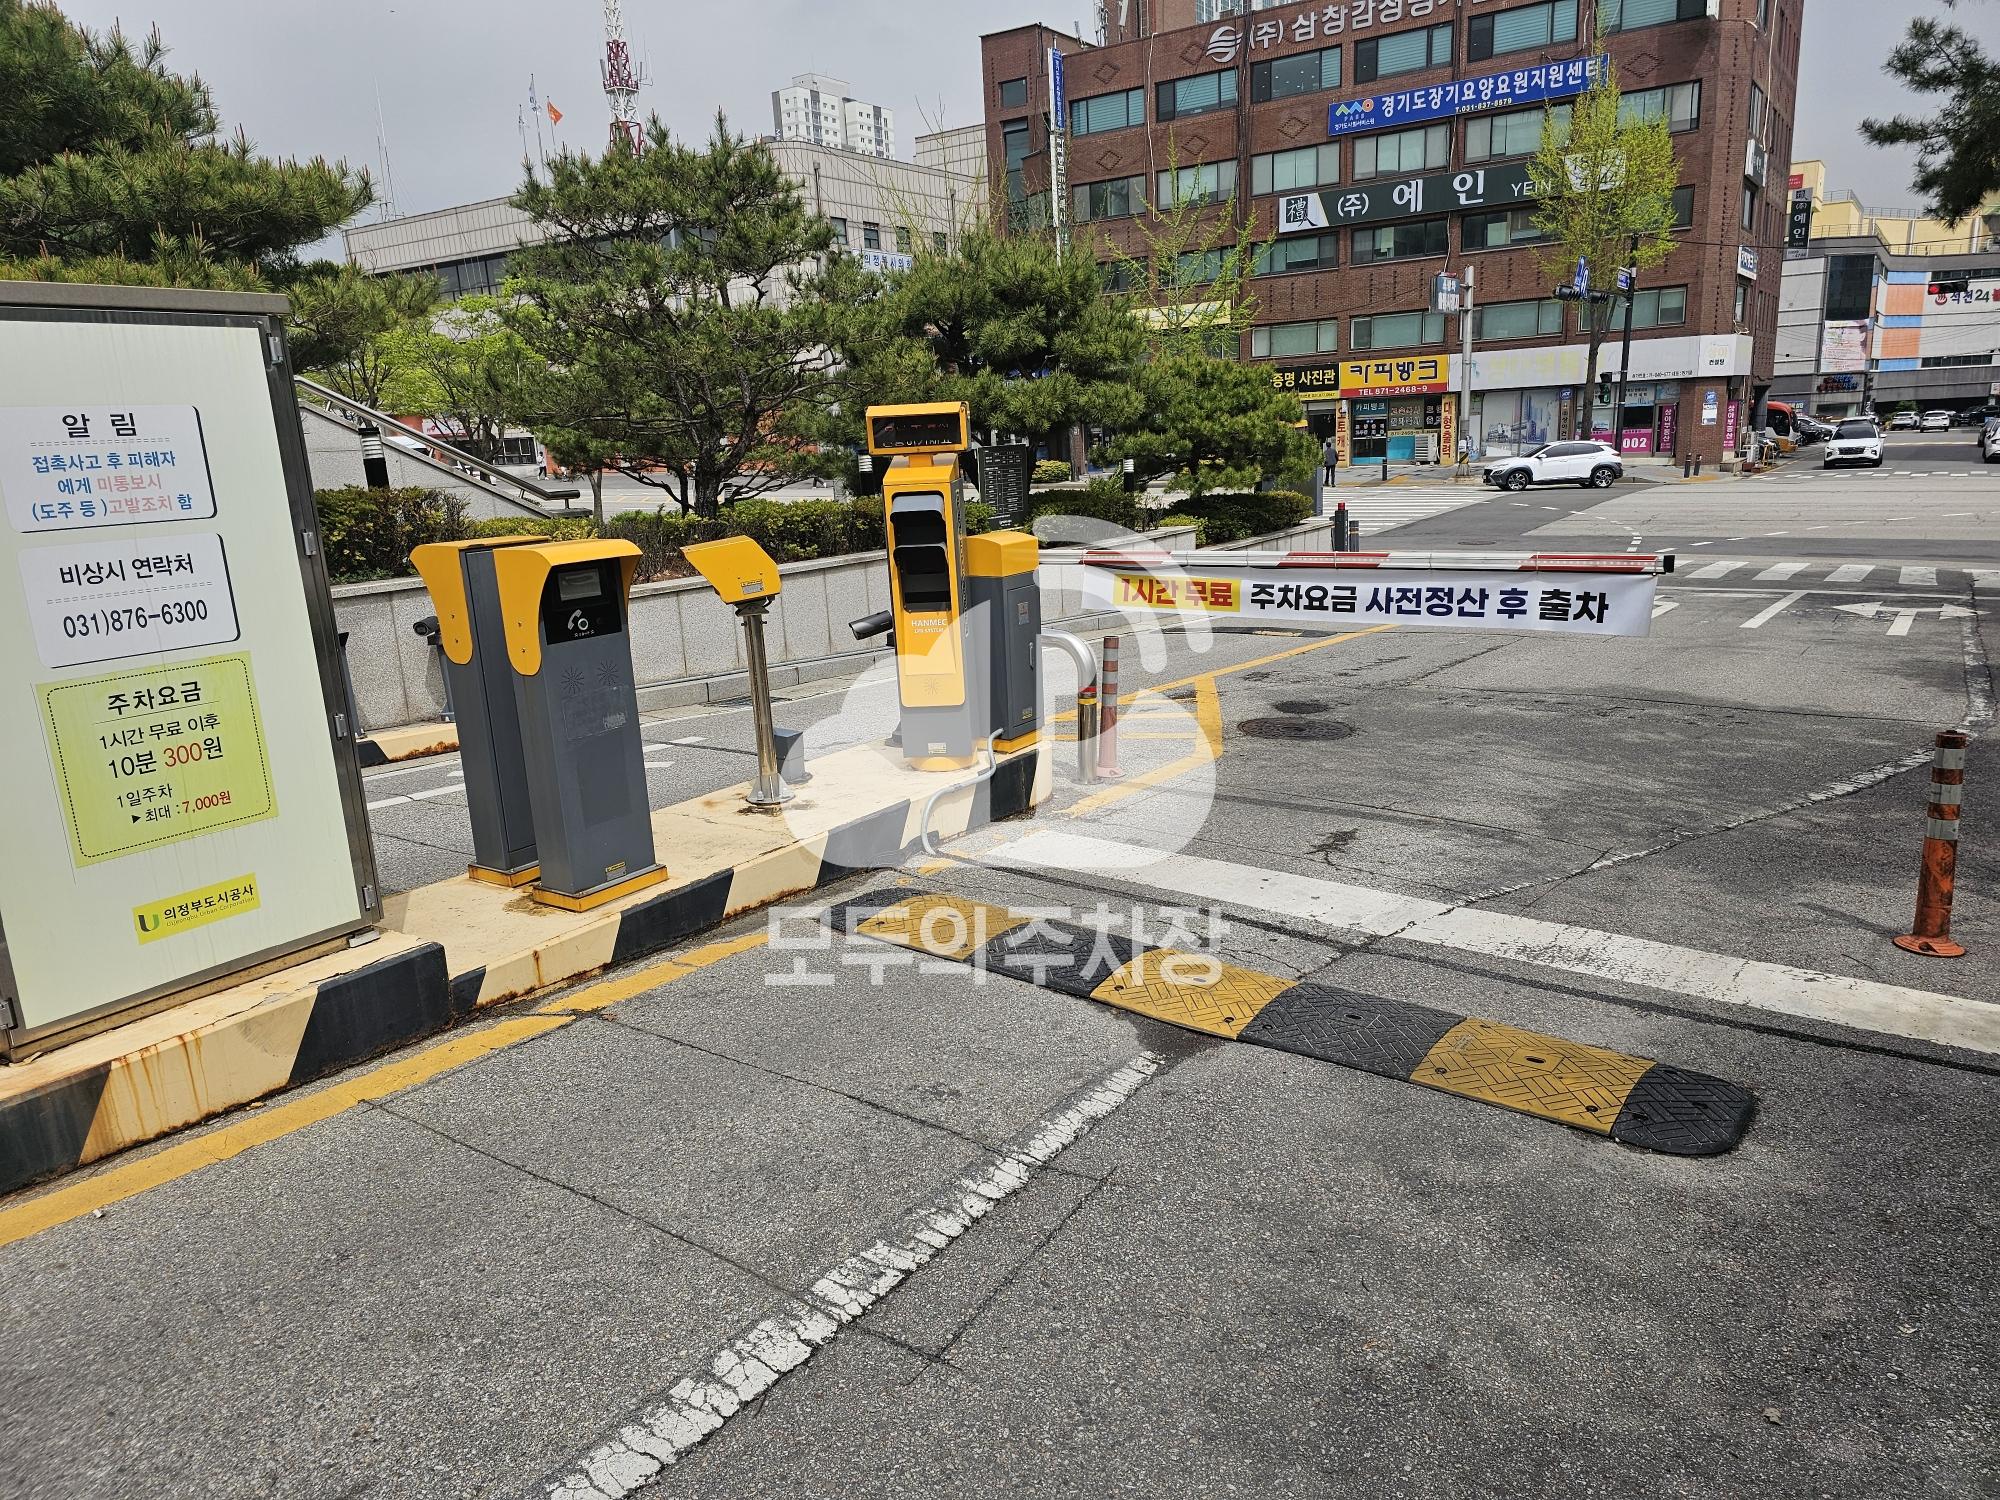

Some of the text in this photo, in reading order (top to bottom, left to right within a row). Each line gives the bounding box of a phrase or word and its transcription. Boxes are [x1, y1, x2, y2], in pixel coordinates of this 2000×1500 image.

[1381, 58, 1602, 118] 경기도장기요양요원지원센터
[1337, 192, 1370, 217] (주)
[1299, 368, 1336, 386] 사진관
[1350, 360, 1438, 383] 카피뱅크
[1375, 385, 1428, 395] 871-2468-9
[32, 450, 176, 474] 접촉사고 후 피해자
[57, 473, 162, 495] 에게 미통보시
[176, 493, 193, 510] 함
[59, 552, 195, 587] 비상시 연락처
[1121, 578, 1610, 624] 1시간 무료 주차요금 사전정산 후 출차
[62, 599, 209, 639] 031)876-6300
[107, 680, 202, 716] 주차요금
[99, 713, 221, 750] 1시간 무료 이후
[108, 736, 224, 779] 10분 300원
[145, 804, 172, 823] 최대
[164, 883, 254, 920] 의정부도시공사
